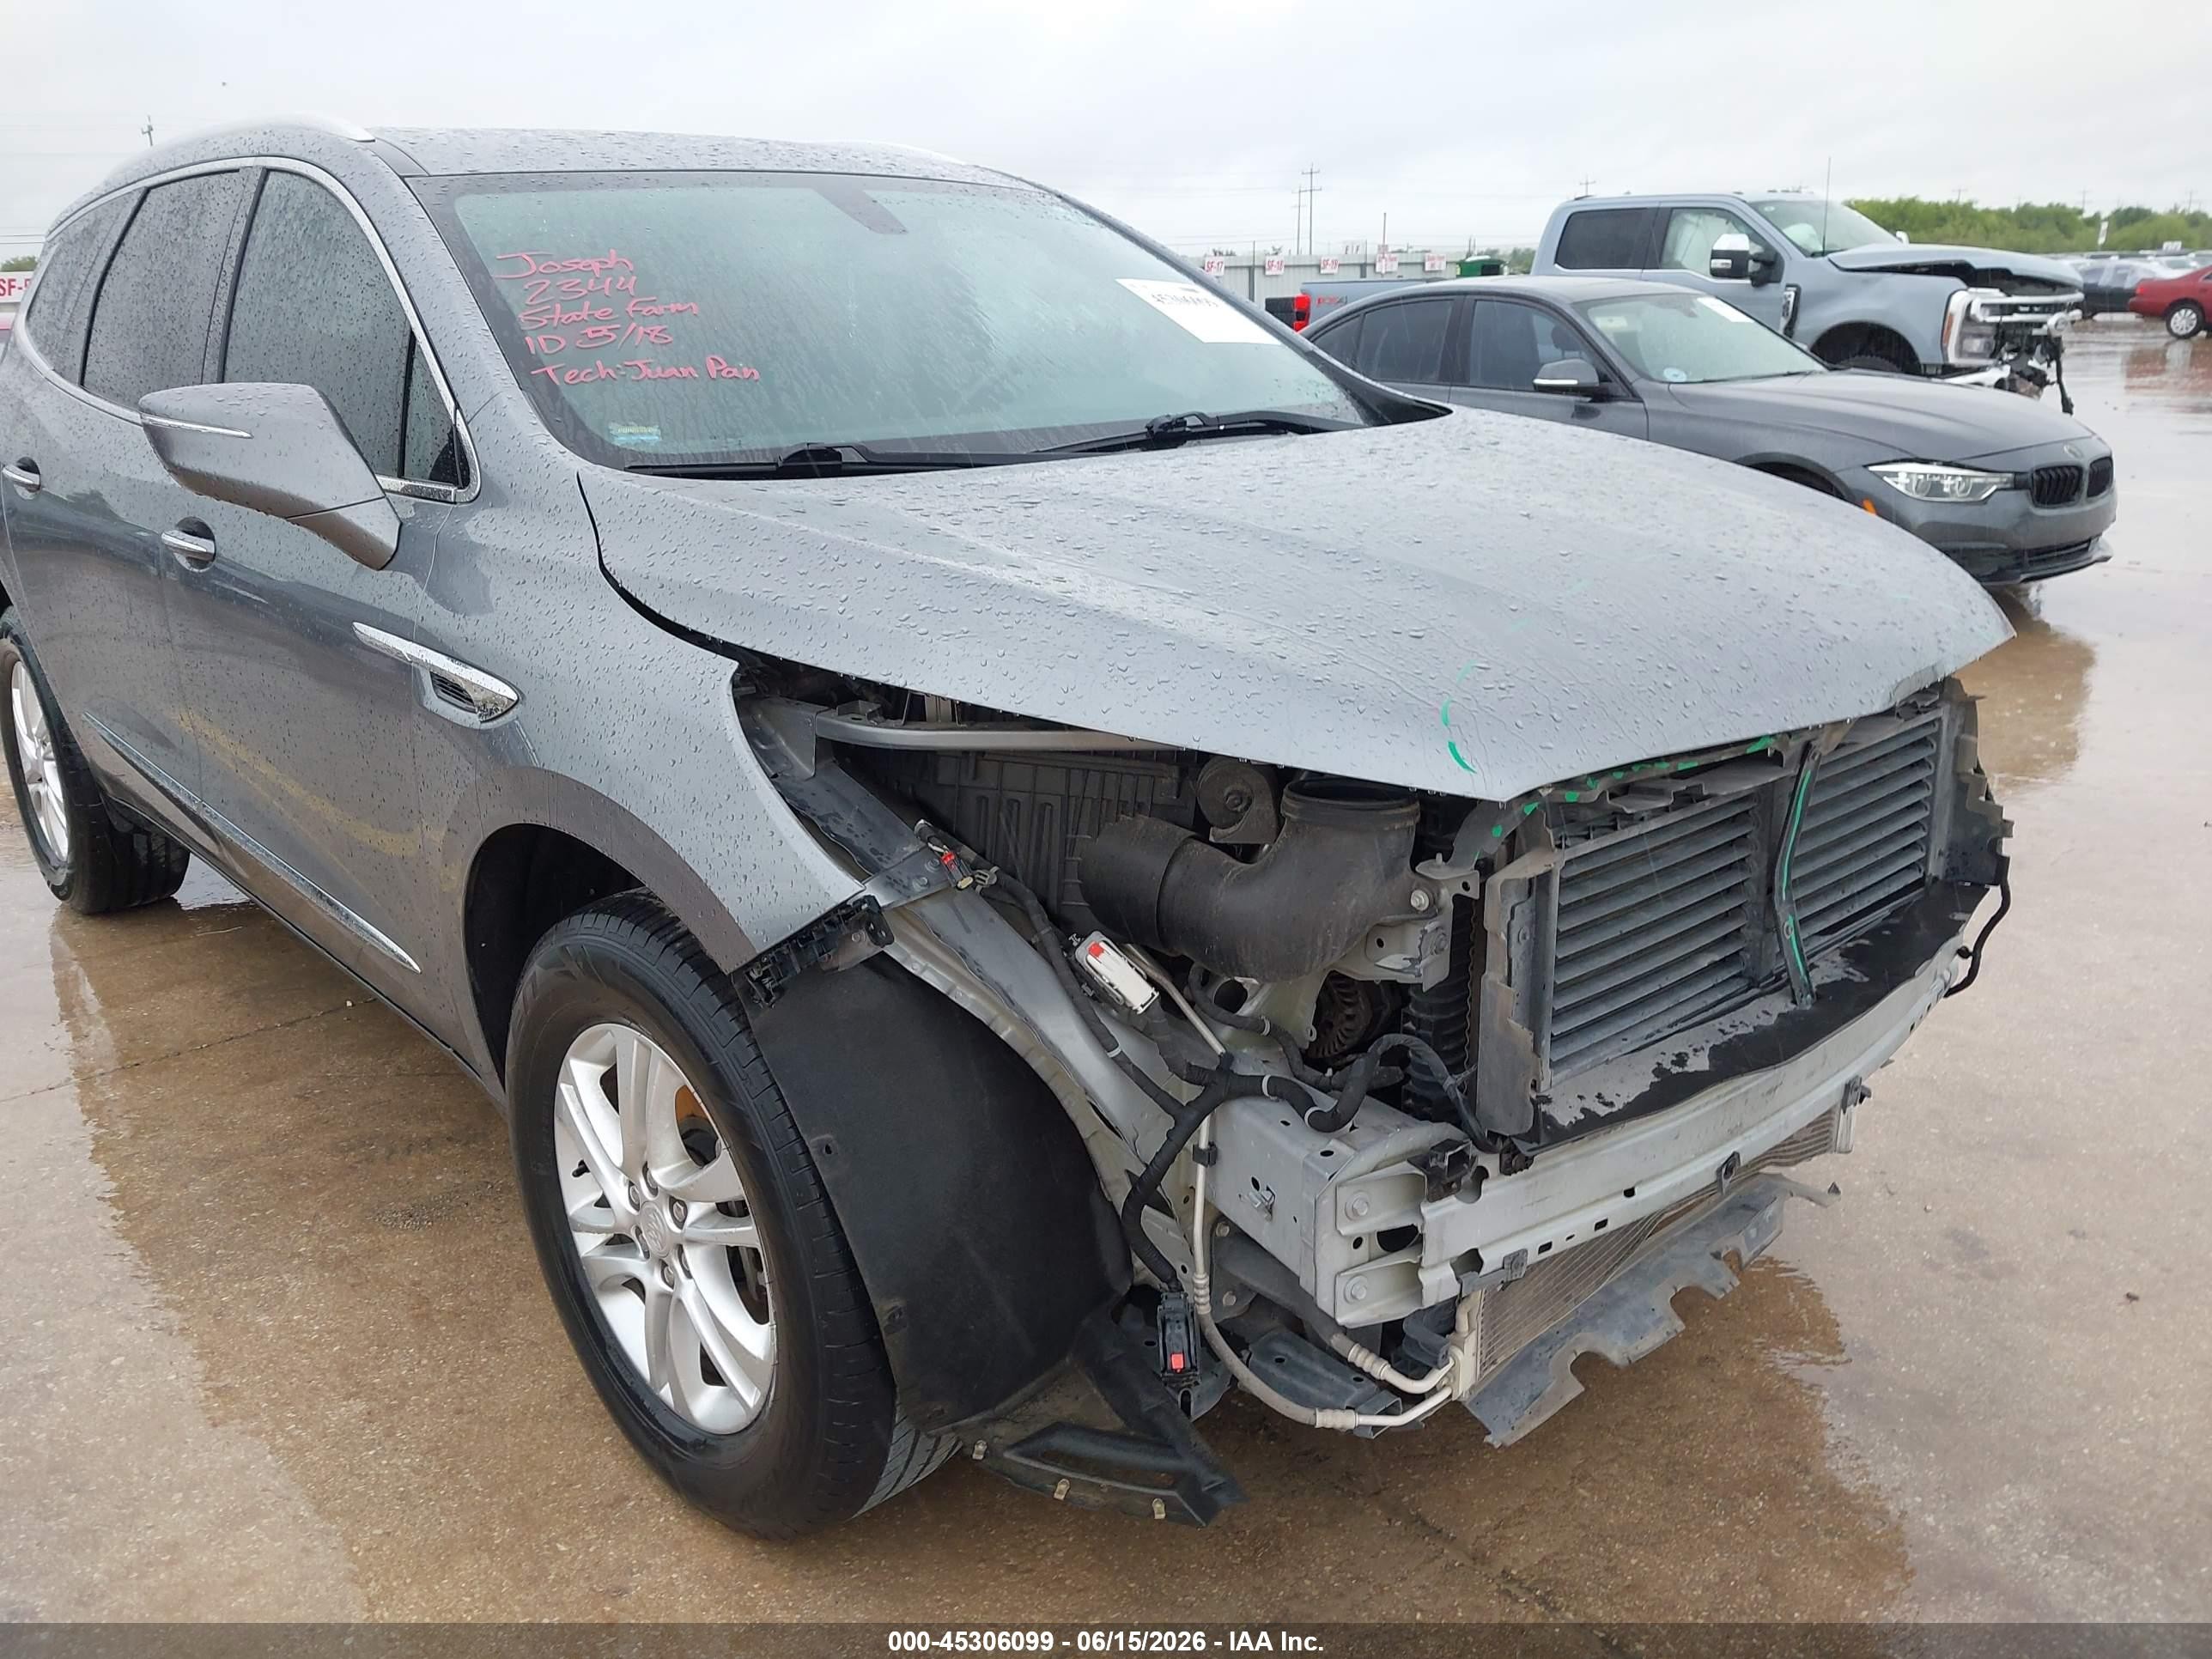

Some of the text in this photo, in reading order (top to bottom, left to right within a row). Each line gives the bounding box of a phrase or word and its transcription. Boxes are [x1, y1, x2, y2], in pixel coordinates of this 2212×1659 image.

[495, 249, 634, 279] Joseph
[525, 276, 636, 305] 2344
[520, 296, 699, 330] State Farm
[576, 322, 674, 349] 5/18
